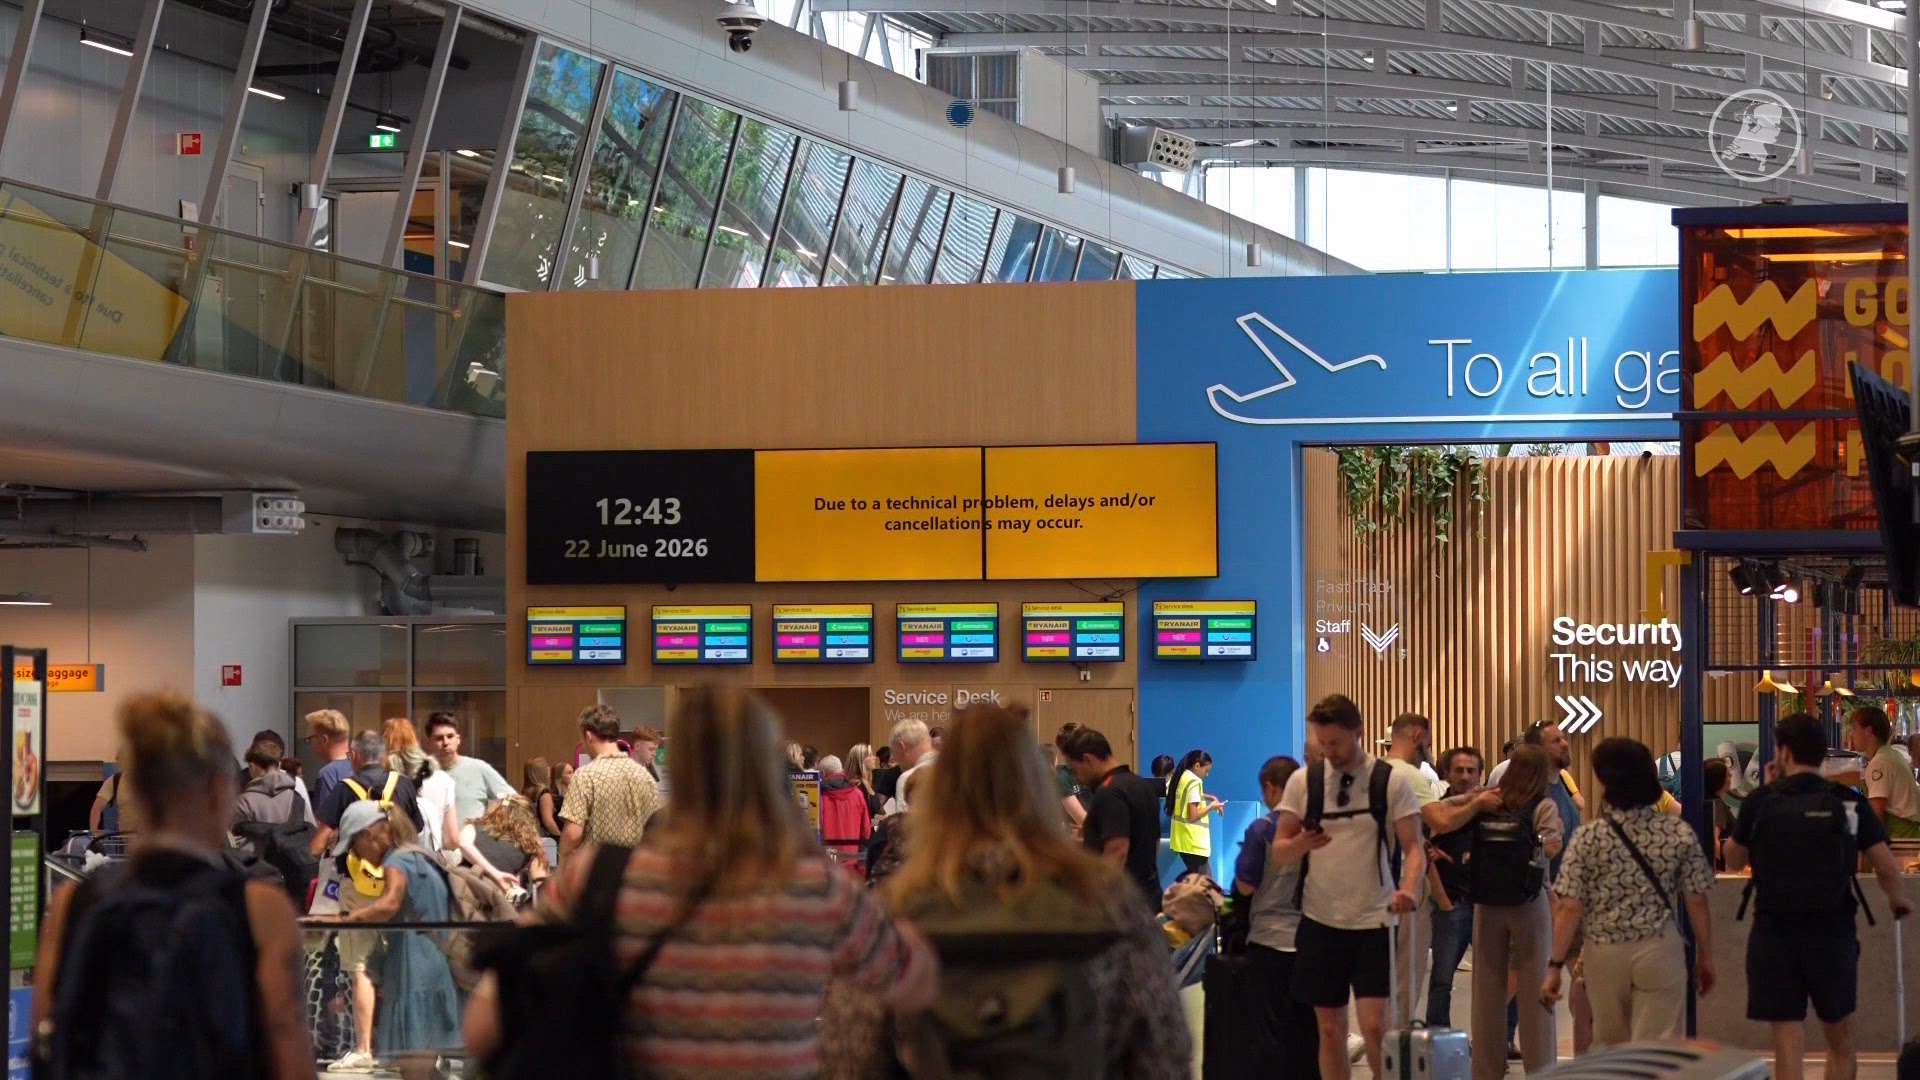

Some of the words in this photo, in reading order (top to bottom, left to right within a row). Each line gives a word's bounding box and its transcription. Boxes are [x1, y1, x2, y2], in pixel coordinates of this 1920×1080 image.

[1428, 338, 1503, 397] To
[1527, 337, 1588, 396] all
[814, 497, 846, 511] Due
[851, 498, 867, 511] to
[886, 495, 957, 510] technical
[962, 495, 1040, 513] problem,
[1044, 494, 1095, 511] delays
[1100, 493, 1156, 509] and/or
[596, 498, 682, 526] 12:43
[884, 516, 993, 531] cancellations
[997, 519, 1032, 533] may
[1036, 518, 1084, 529] occur.
[564, 539, 590, 558] 22
[596, 539, 649, 558] June
[654, 538, 709, 558] 2026
[1316, 580, 1350, 593] Fast
[1355, 580, 1393, 593] Track
[1316, 600, 1371, 612] Privium
[1315, 619, 1351, 633] Staff
[47, 669, 89, 679] aggage
[1550, 653, 1614, 682] This
[1622, 659, 1682, 688] way
[884, 689, 948, 705] Service
[957, 689, 1000, 705] Desk
[885, 708, 905, 721] We
[909, 710, 928, 720] are
